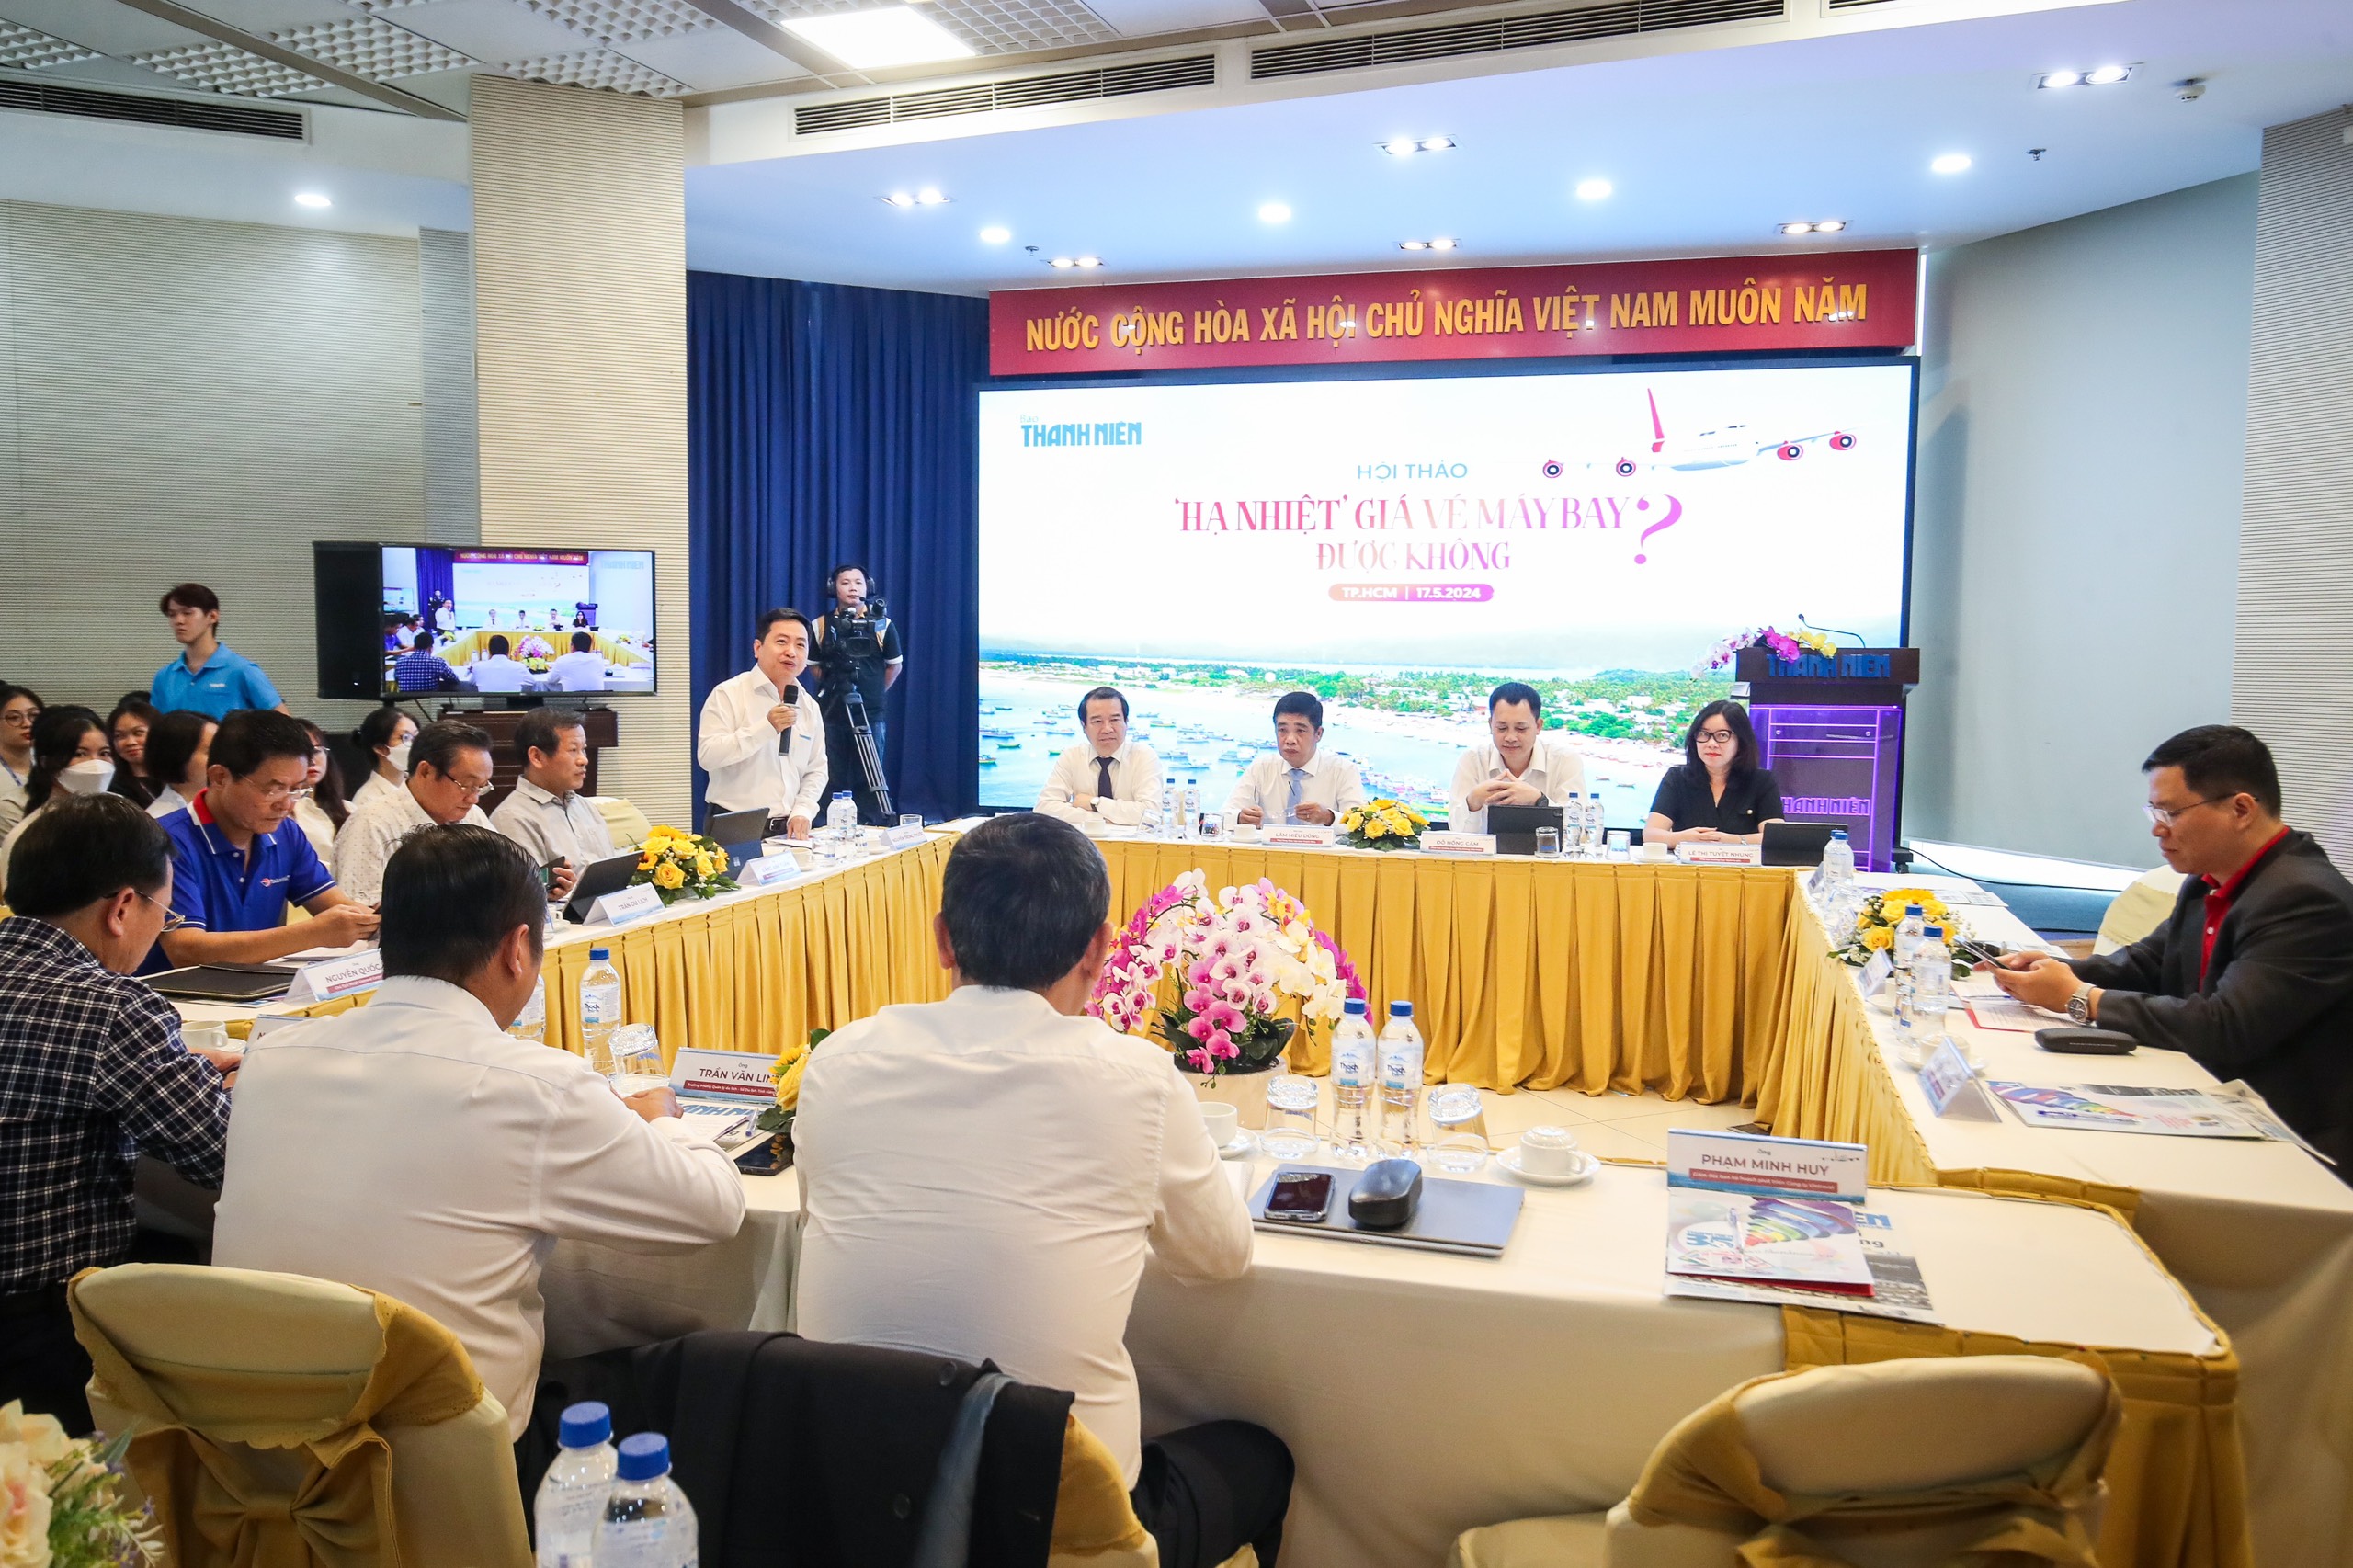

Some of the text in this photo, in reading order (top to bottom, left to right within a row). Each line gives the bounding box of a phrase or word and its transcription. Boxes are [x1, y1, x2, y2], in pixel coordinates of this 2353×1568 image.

[1025, 276, 1868, 355] NƯỚC CỘNG HÒA XÃ HỘI CHỦ NGHĨA VIỆT NAM MUÔN NĂM
[1020, 423, 1091, 447] THANH
[1354, 494, 1415, 530] GIÁ
[1422, 494, 1468, 529] VÉ
[1476, 493, 1556, 530] MÁY
[1560, 496, 1631, 529] BAY
[1315, 538, 1510, 574] ĐƯỢC KHÔNG
[1341, 587, 1482, 599] TP.HCM 17.5.2024
[1767, 653, 1837, 678] THANH
[1780, 797, 1829, 815] HANH
[699, 1066, 779, 1084] TRẦN VĂN LIN
[1701, 1153, 1830, 1176] PHẠM MINH HUY
